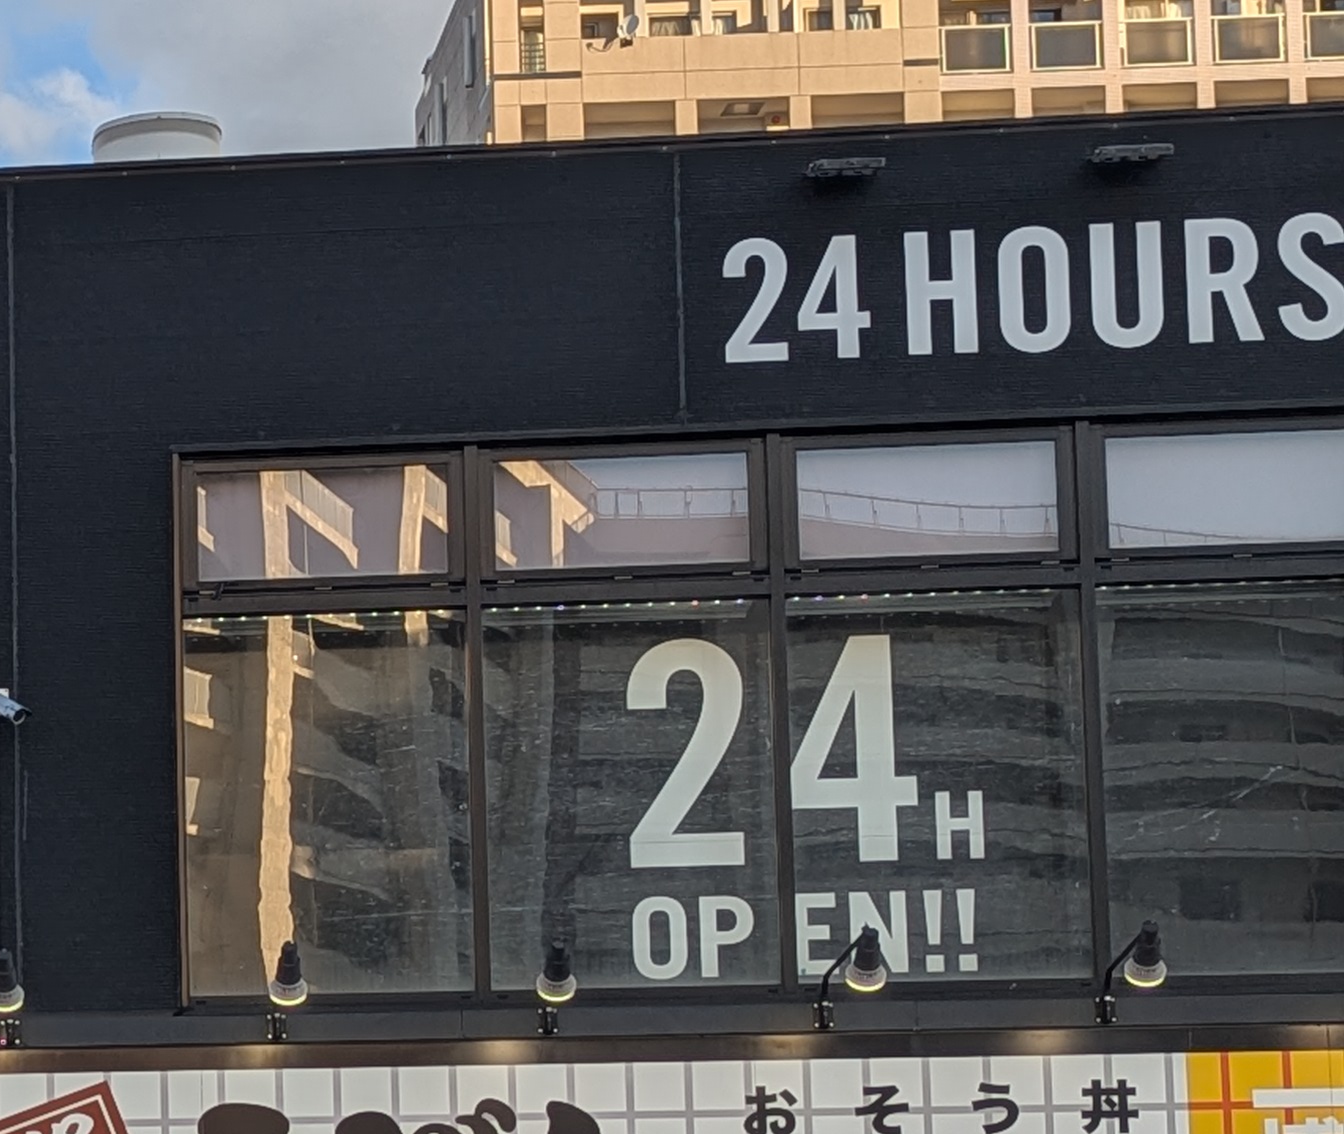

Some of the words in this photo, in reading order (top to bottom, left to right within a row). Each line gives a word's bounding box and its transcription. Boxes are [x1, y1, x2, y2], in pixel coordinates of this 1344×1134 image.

[722, 234, 871, 364] 24
[903, 212, 1344, 356] HOURS
[625, 633, 986, 870] 24H
[631, 888, 980, 981] OPEN!!
